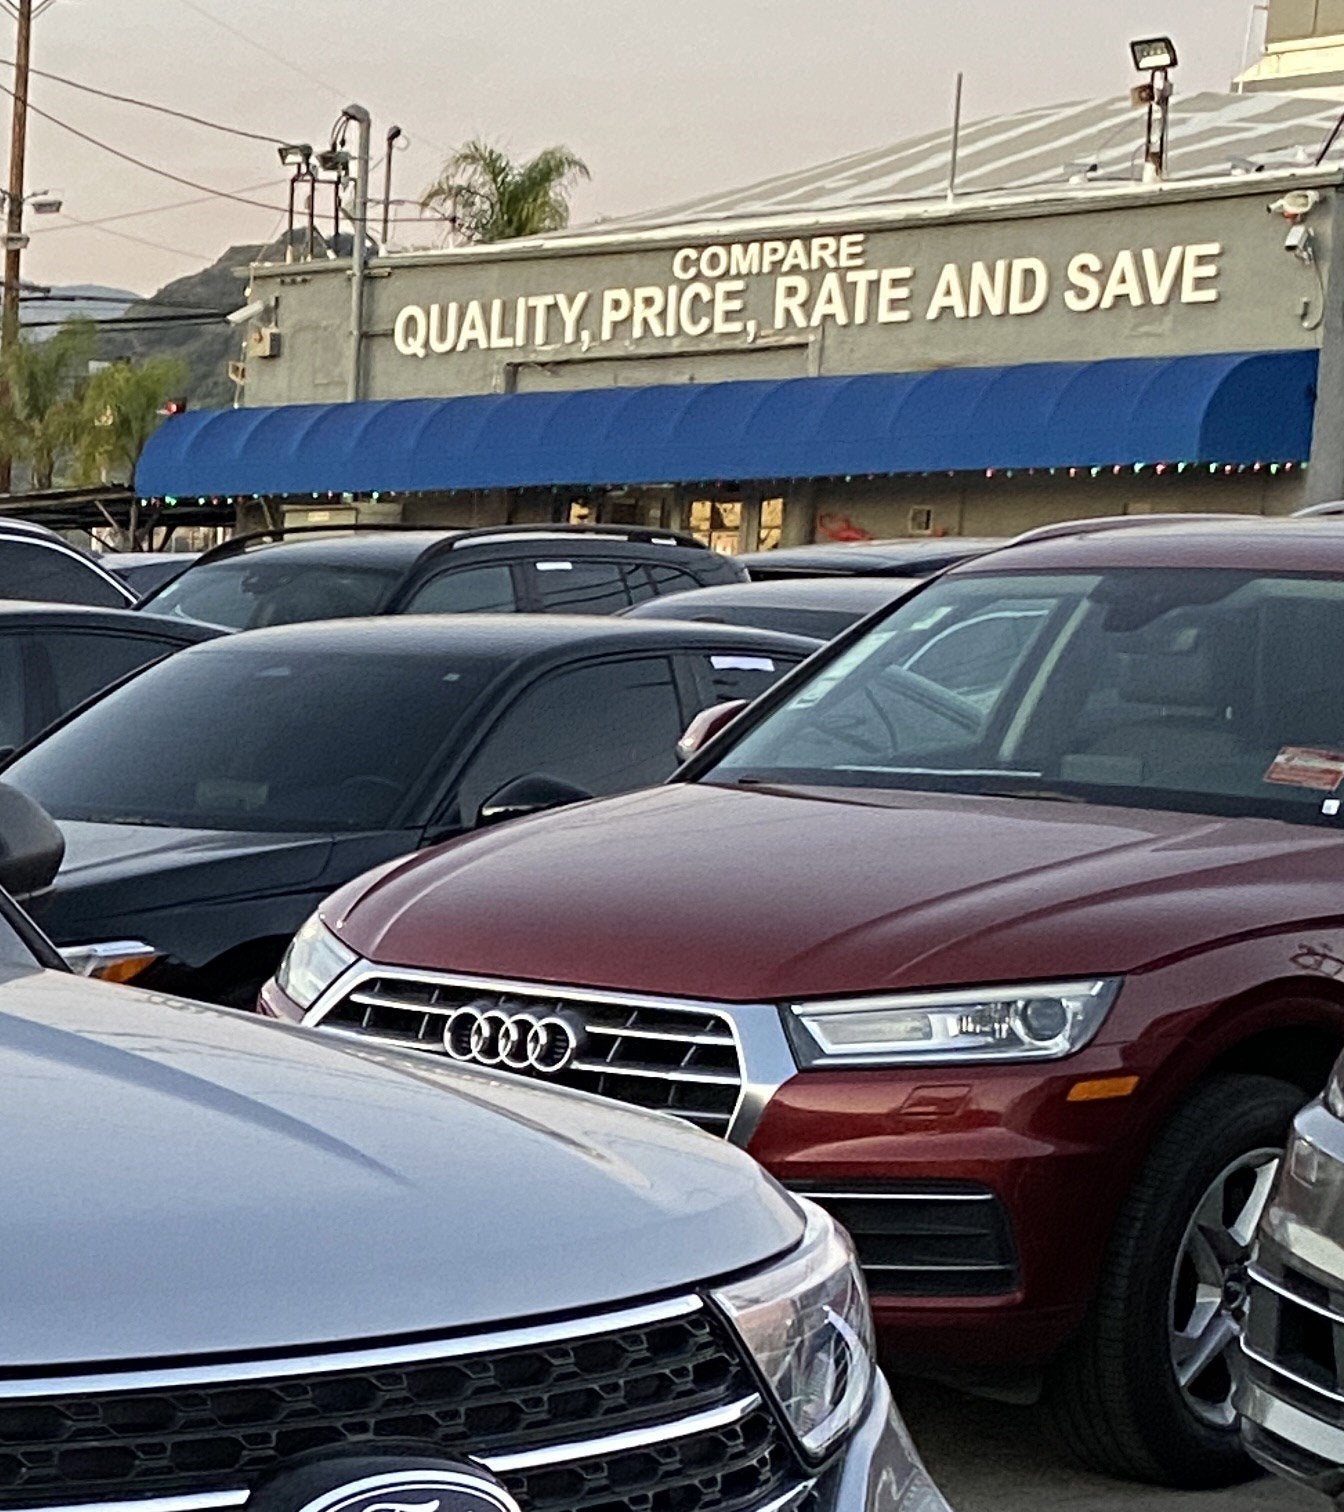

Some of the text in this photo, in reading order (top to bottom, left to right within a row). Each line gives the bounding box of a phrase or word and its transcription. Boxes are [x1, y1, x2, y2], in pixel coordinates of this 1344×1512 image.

[672, 233, 865, 280] COMPARE
[394, 242, 1221, 358] QUALITY, PRICE, RATE AND SAVE
